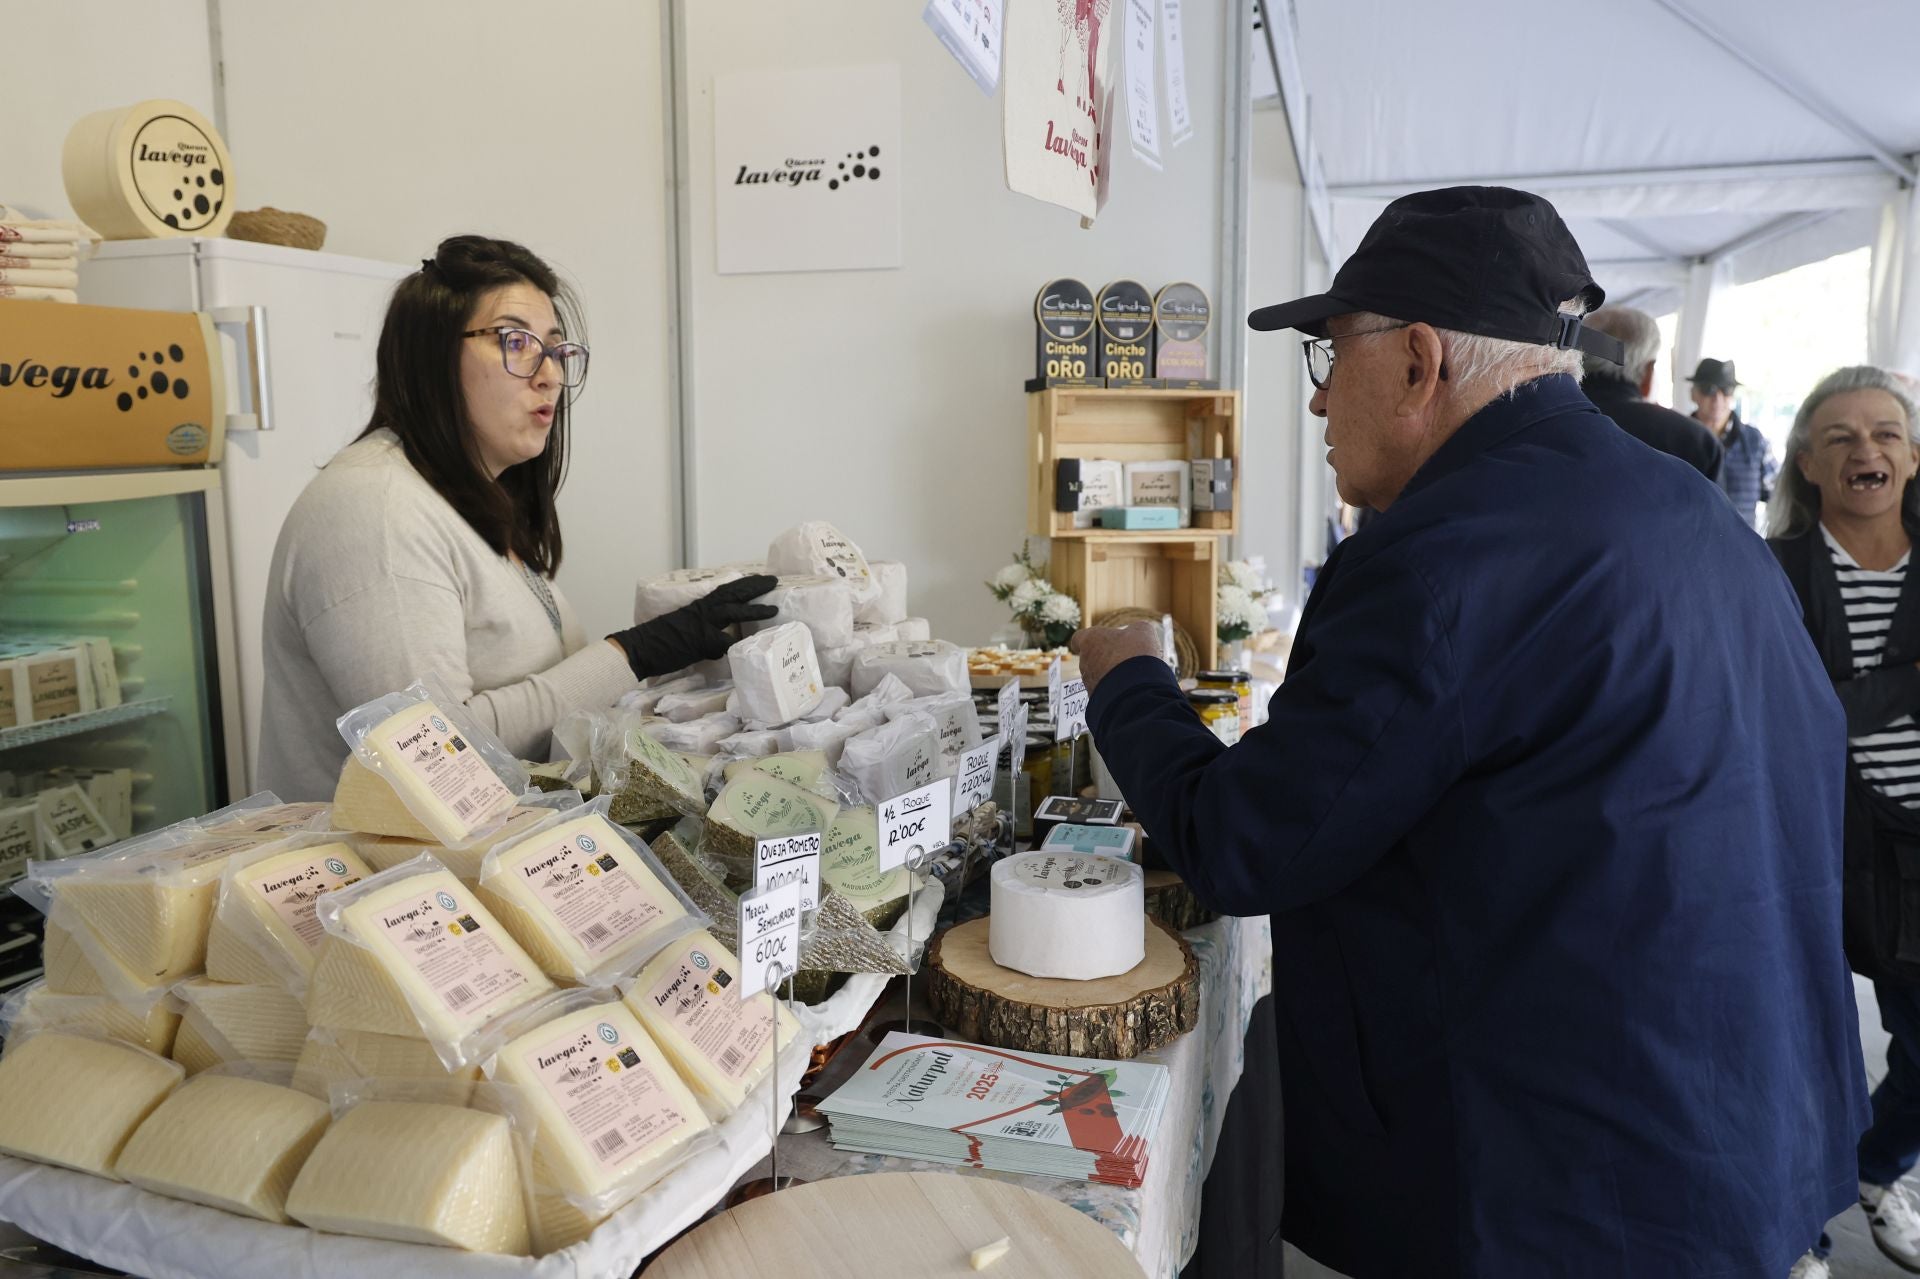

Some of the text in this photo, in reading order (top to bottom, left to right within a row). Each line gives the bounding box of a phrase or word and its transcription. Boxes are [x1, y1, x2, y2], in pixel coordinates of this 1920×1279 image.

[139, 144, 206, 167] lavega
[1045, 120, 1087, 170] lavega
[734, 165, 823, 186] lavega
[1046, 341, 1087, 356] Cincho
[1105, 342, 1146, 356] Cincho
[1047, 359, 1086, 378] ORO
[1106, 360, 1144, 378] ORO
[396, 732, 422, 752] lavega
[744, 791, 771, 818] lavega
[902, 792, 931, 810] ROQUE
[888, 817, 926, 847] 12'00€
[760, 836, 820, 860] OVEJA ROMERO
[524, 853, 560, 878] lavega
[262, 874, 304, 894] lavega
[383, 908, 420, 930] lavega
[745, 903, 769, 922] MEZCLA
[757, 907, 796, 935] SEMICURADO
[755, 935, 788, 964] 6'00€
[653, 977, 683, 1007] lavega
[537, 1045, 578, 1070] lavega
[886, 1049, 955, 1113] Naturpal
[965, 1073, 999, 1101] 2025
